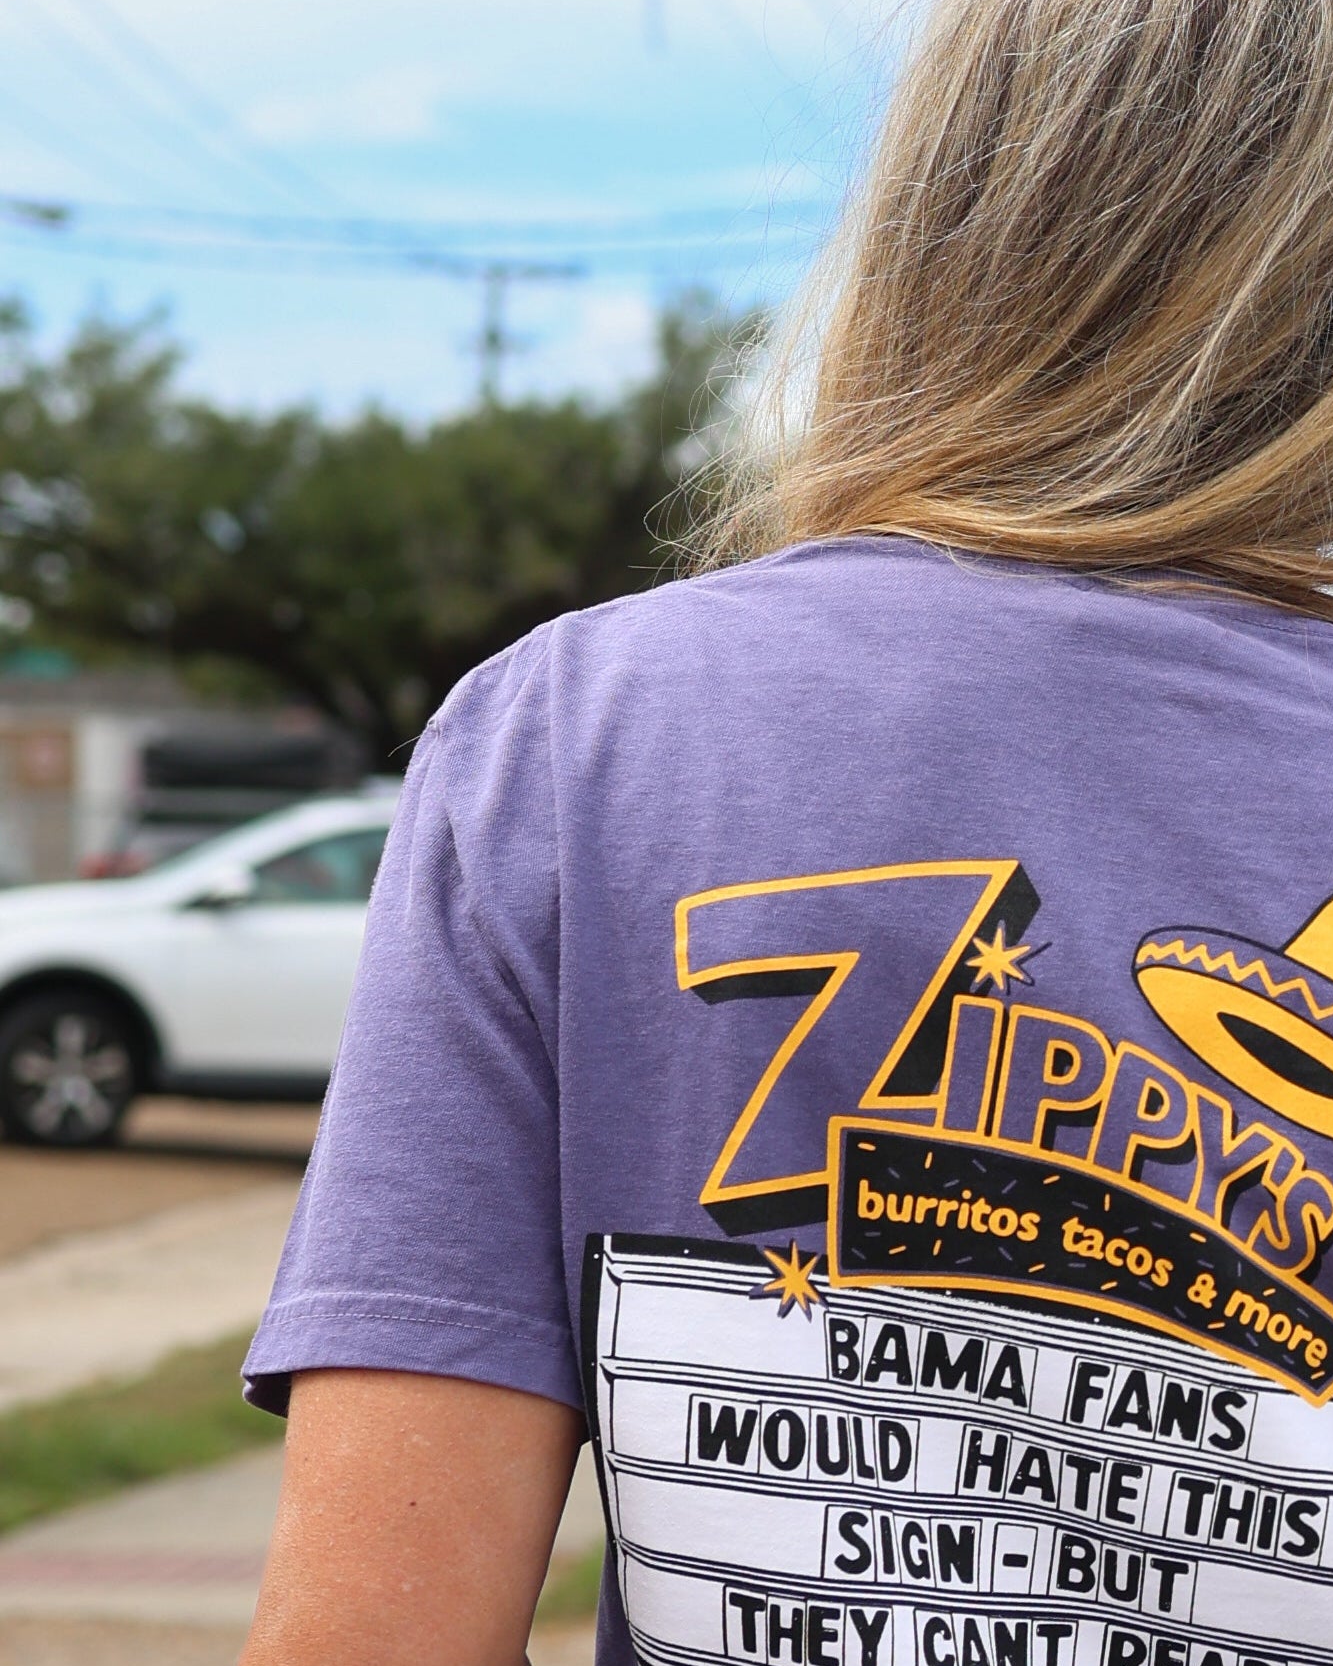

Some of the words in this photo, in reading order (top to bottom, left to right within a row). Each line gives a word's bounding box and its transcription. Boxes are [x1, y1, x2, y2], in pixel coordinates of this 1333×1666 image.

[857, 1180, 1041, 1242] burritos
[1061, 1217, 1173, 1287] tacos
[1187, 1271, 1217, 1311] &
[1223, 1289, 1329, 1369] more
[828, 1317, 1029, 1409] BAMA
[1071, 1363, 1248, 1452] FANS
[697, 1400, 914, 1478] WOULD
[966, 1428, 1146, 1524] HATE
[1177, 1476, 1322, 1557] THIS
